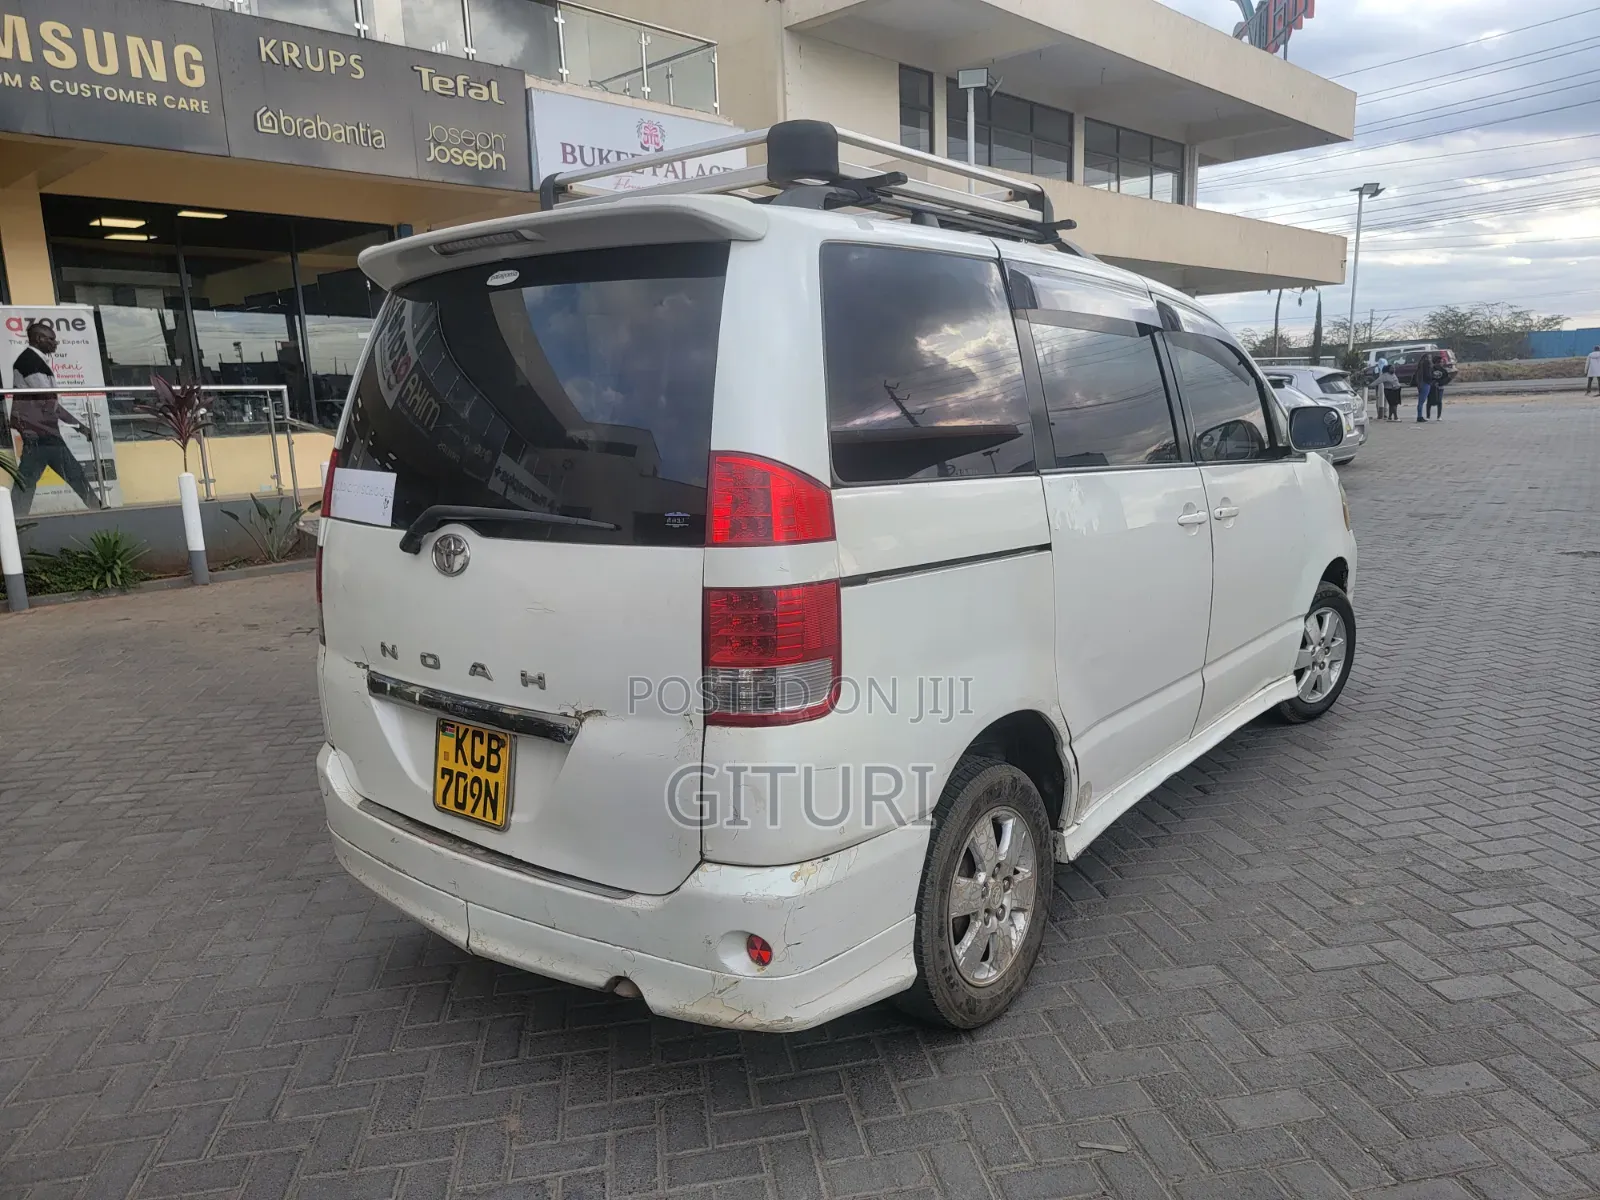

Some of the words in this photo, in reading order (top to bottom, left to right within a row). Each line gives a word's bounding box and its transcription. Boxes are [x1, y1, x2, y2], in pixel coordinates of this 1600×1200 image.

[258, 36, 365, 80] KRUPS
[0, 72, 22, 88] M
[30, 75, 43, 92] &
[50, 79, 157, 107] CUSTOMER
[164, 95, 210, 114] CARE
[413, 65, 505, 105] Tefal
[279, 108, 386, 149] brabantia
[651, 160, 734, 181] PALAC
[380, 641, 547, 691] NOAH
[454, 725, 503, 774] KCB
[440, 767, 500, 821] 709N
